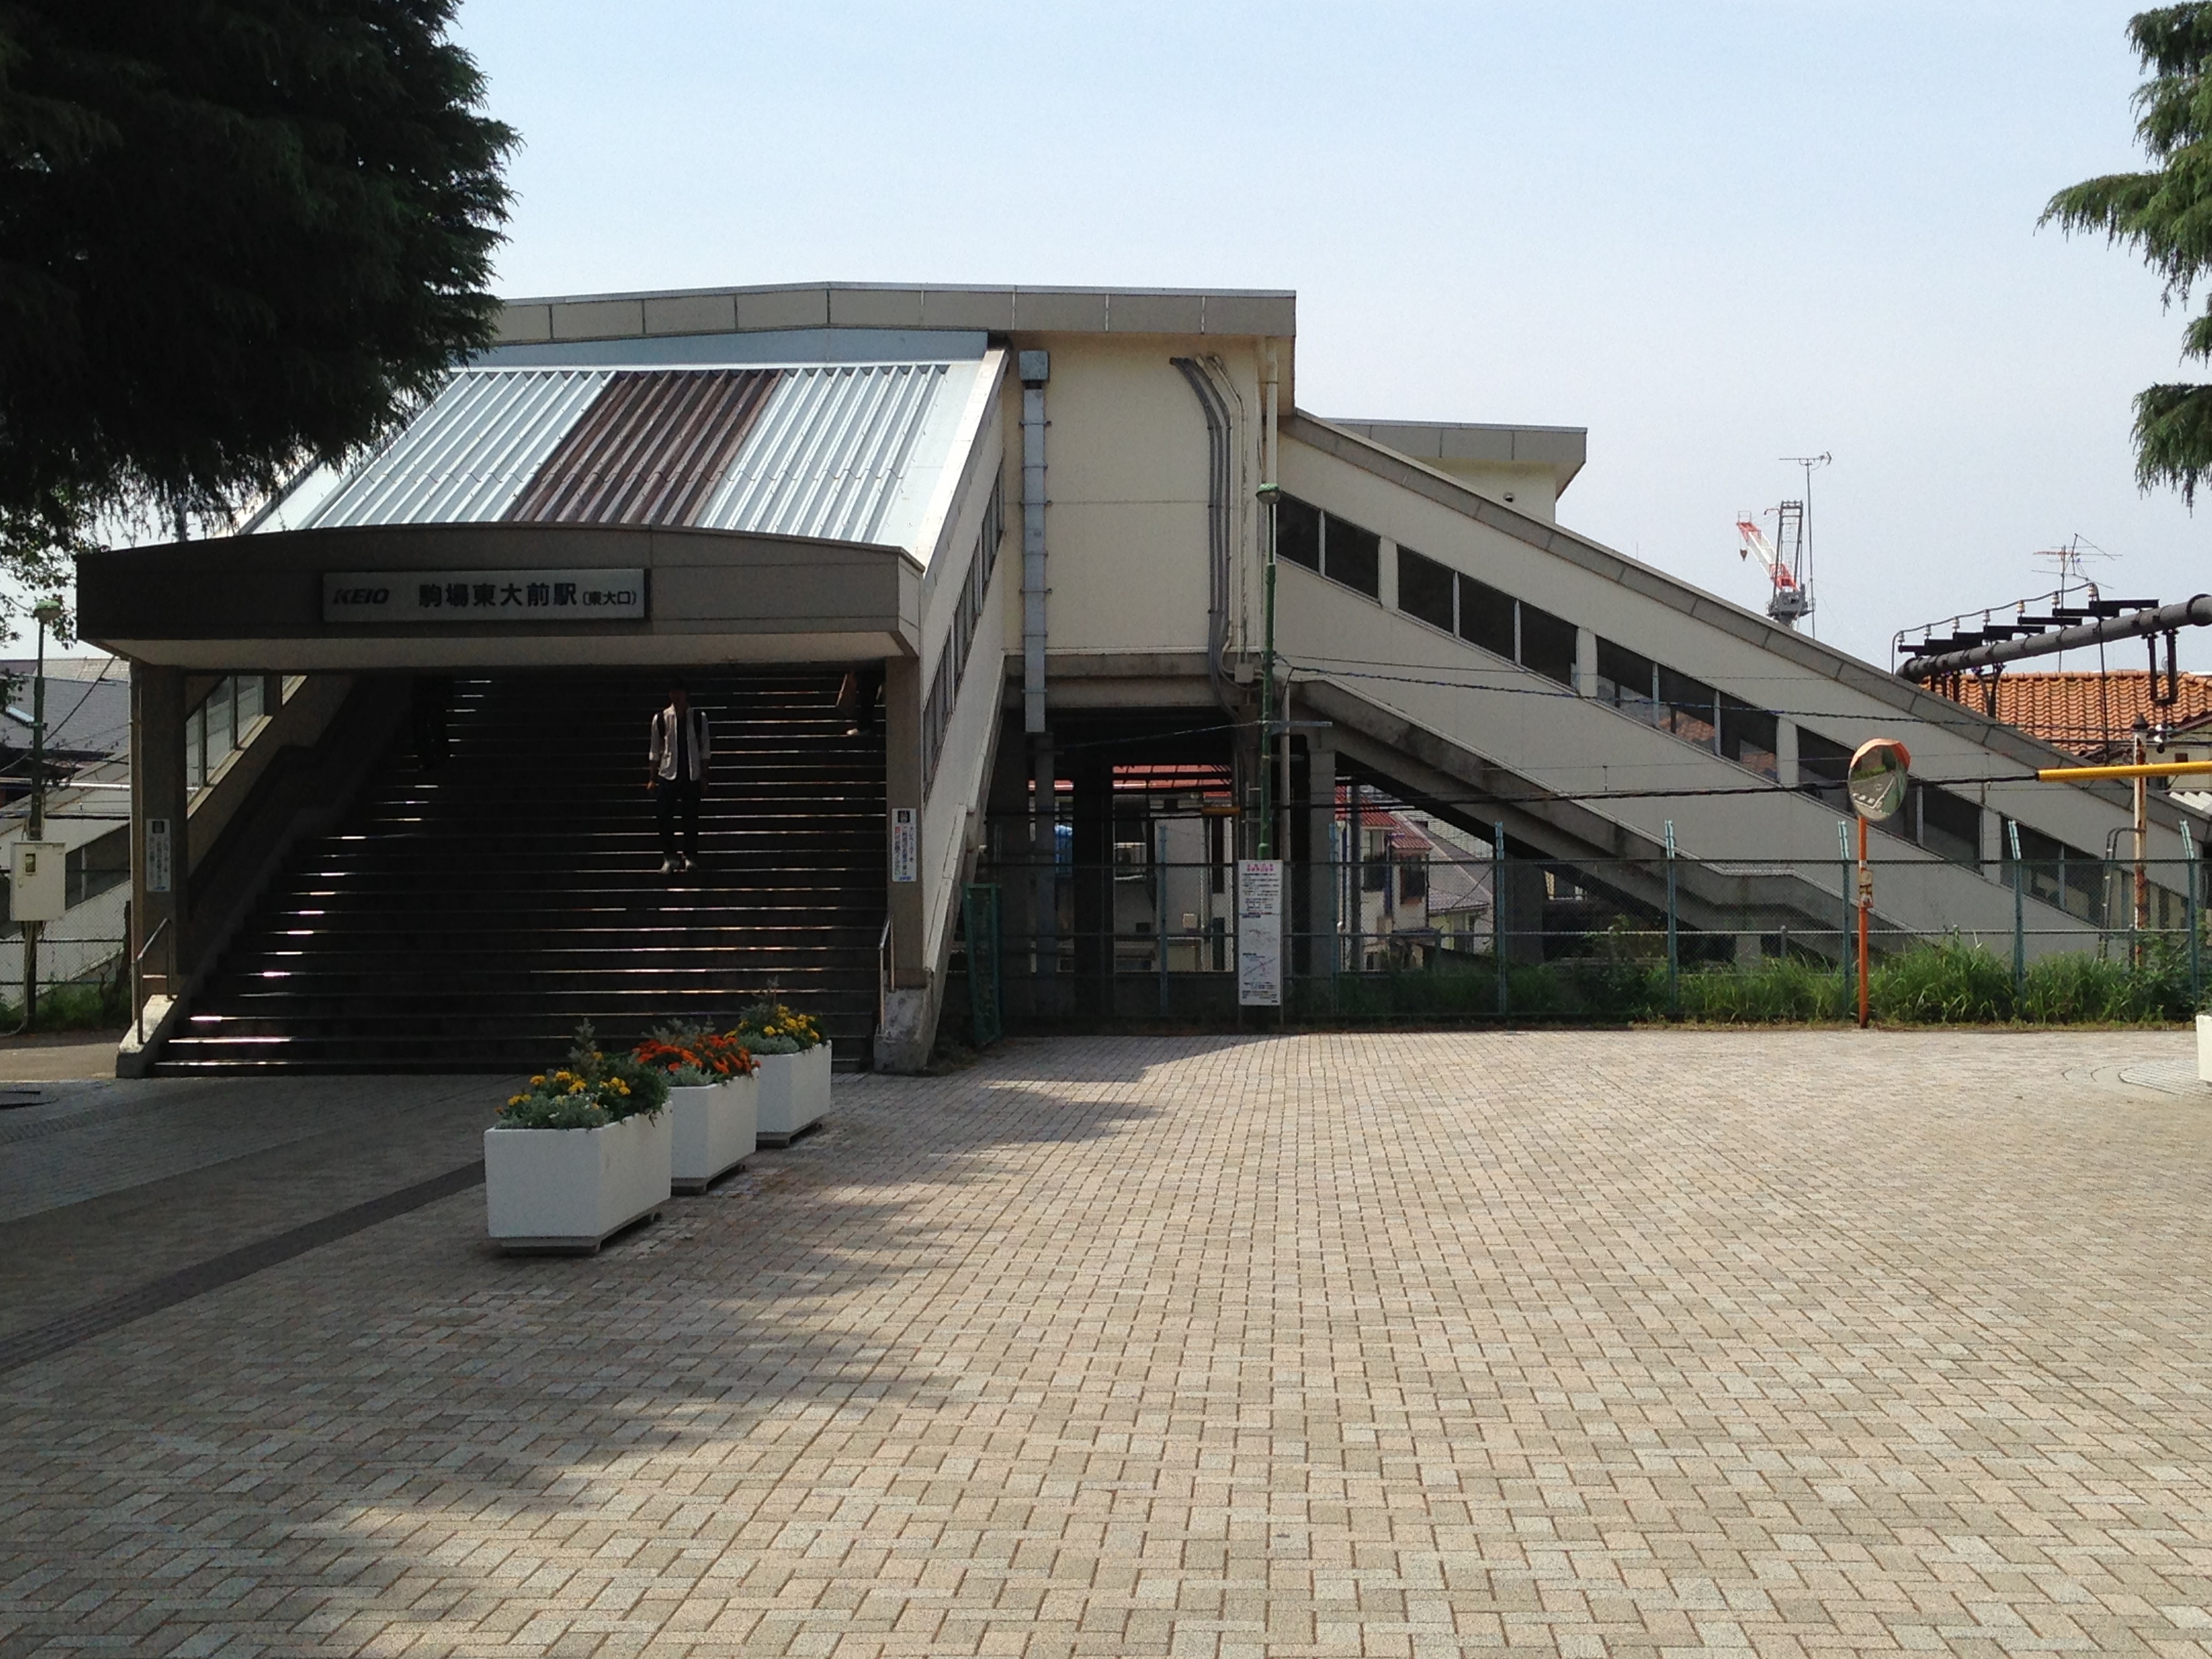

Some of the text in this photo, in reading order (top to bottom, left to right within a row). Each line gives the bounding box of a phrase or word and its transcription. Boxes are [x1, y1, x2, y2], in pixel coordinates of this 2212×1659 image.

[333, 588, 389, 605] KEIO
[418, 583, 576, 607] 駒場東大前駅
